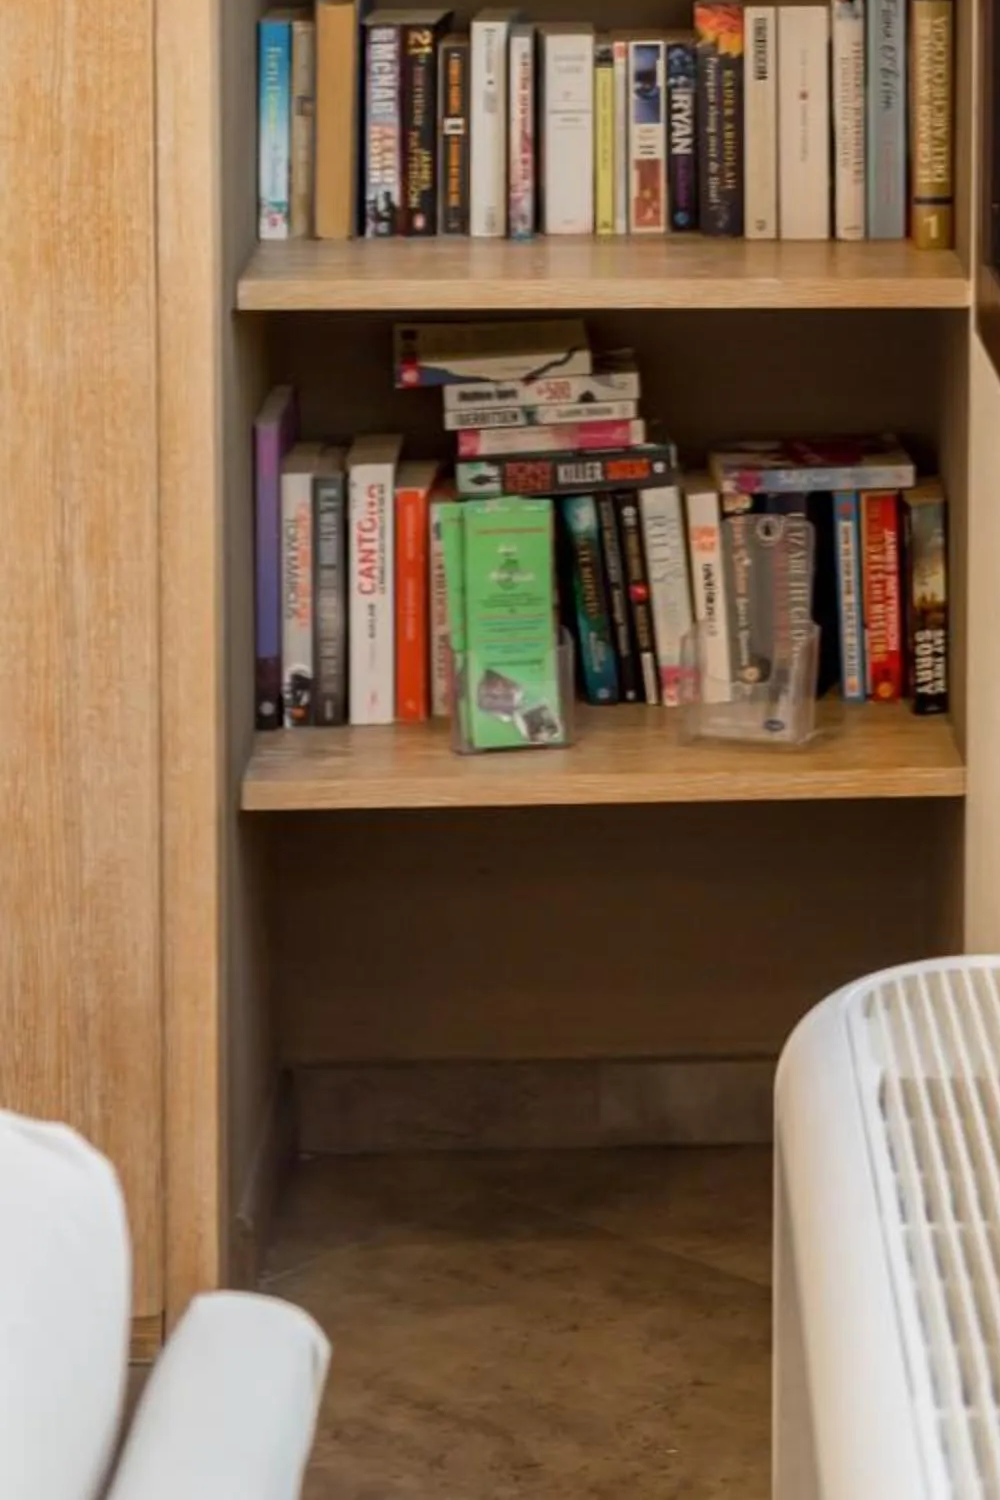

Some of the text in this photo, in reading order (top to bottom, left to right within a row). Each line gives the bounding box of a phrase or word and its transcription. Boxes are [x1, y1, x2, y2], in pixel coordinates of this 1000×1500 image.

[670, 93, 694, 155] RYAN
[923, 215, 939, 240] 1
[557, 461, 604, 484] KILLER
[913, 629, 933, 695] SORRY
